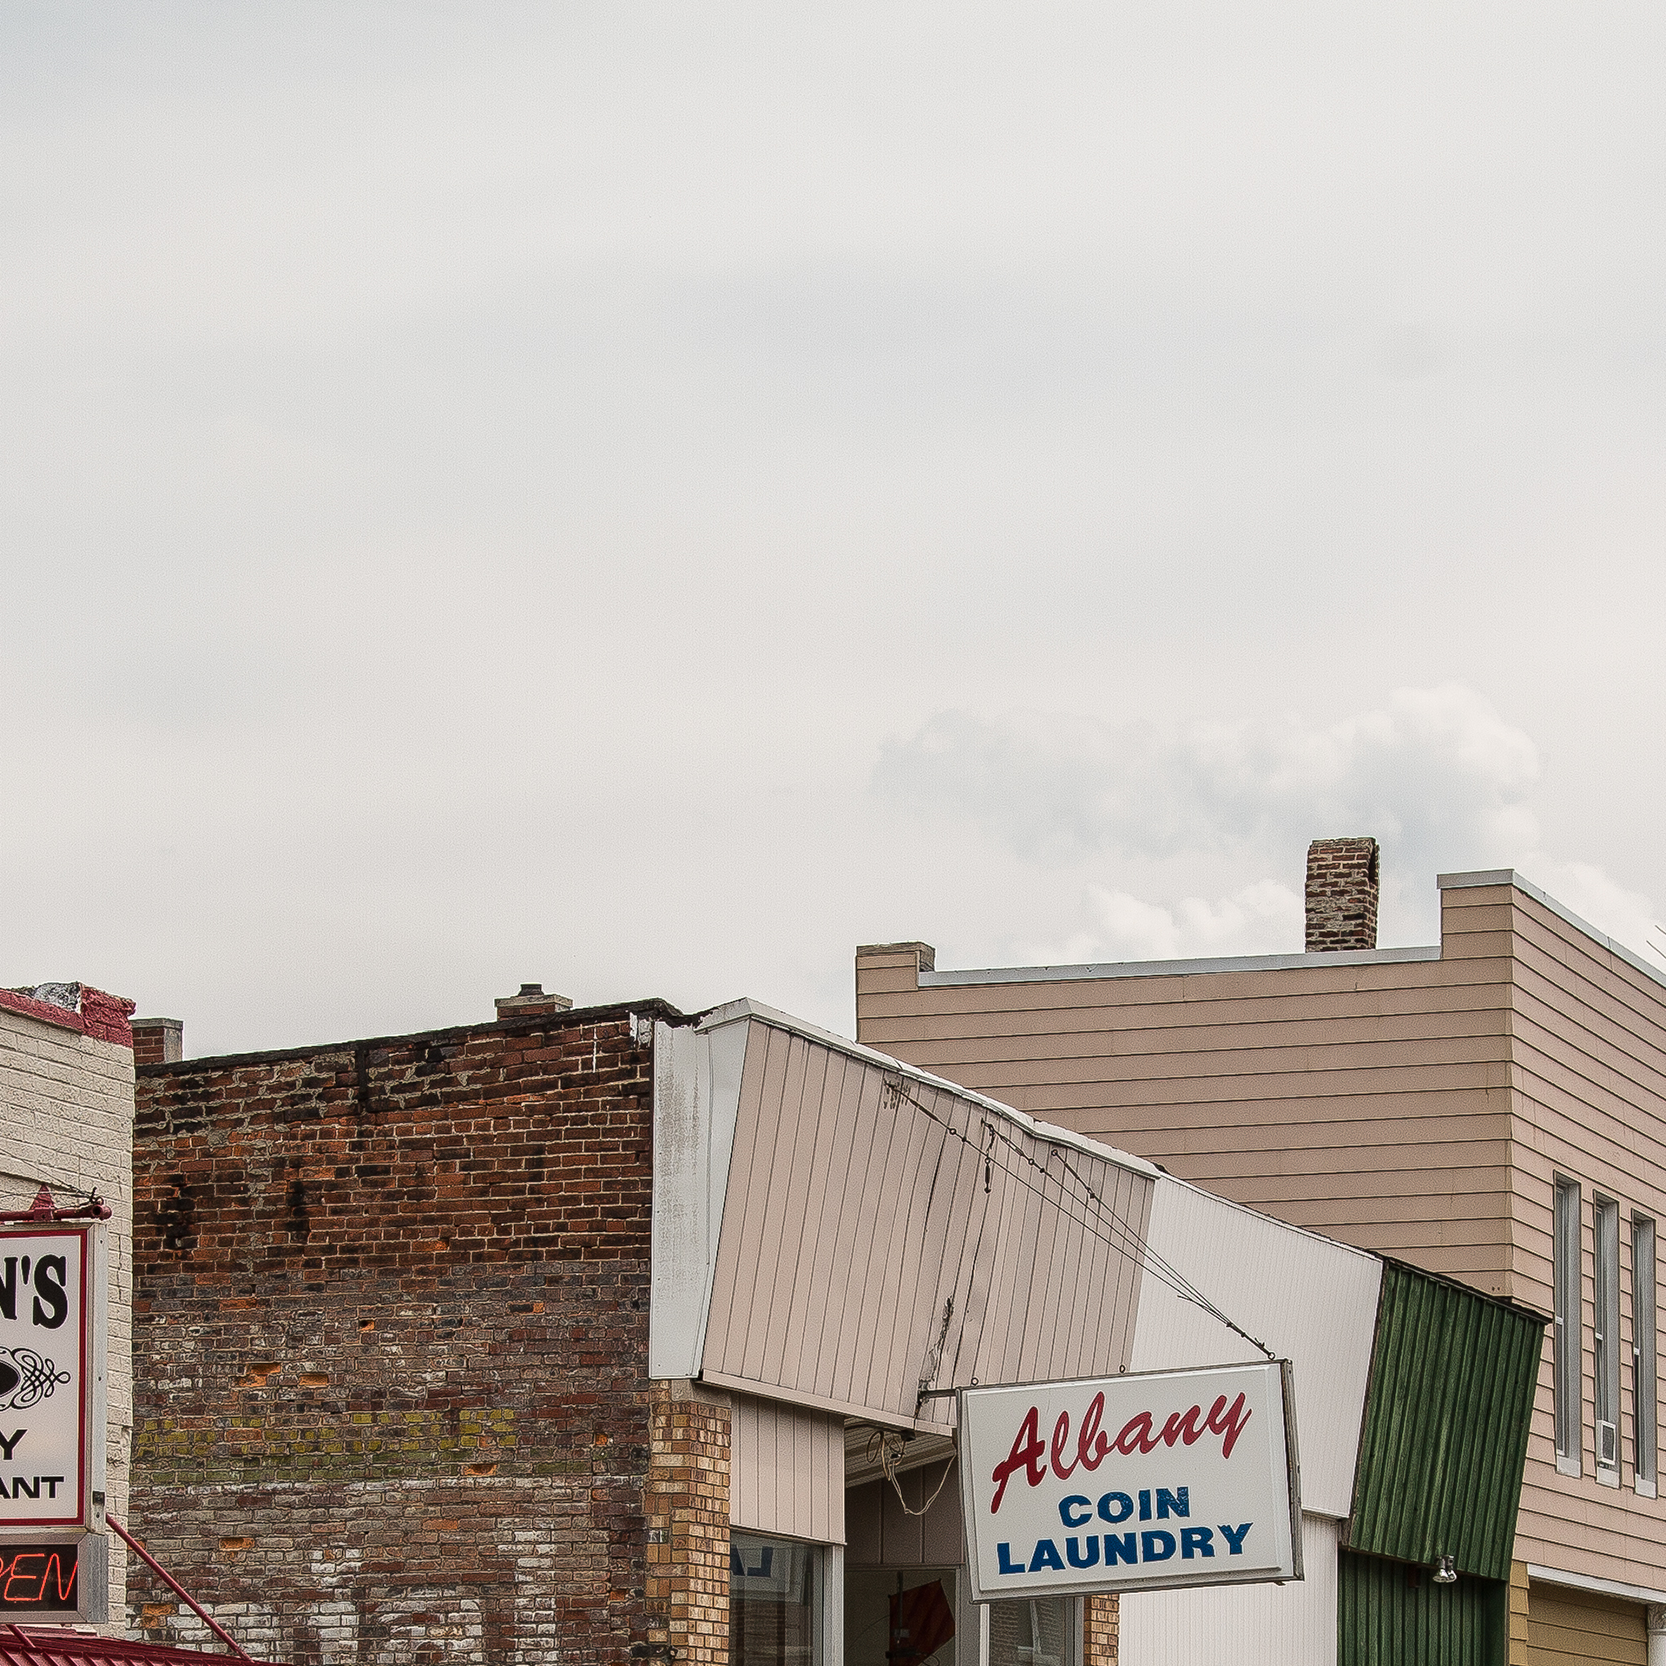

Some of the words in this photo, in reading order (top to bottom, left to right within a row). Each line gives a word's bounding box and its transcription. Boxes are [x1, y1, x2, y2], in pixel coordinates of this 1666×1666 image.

[991, 1391, 1252, 1515] Albany
[1058, 1486, 1191, 1528] COIN
[996, 1522, 1254, 1576] LAUNDRY
